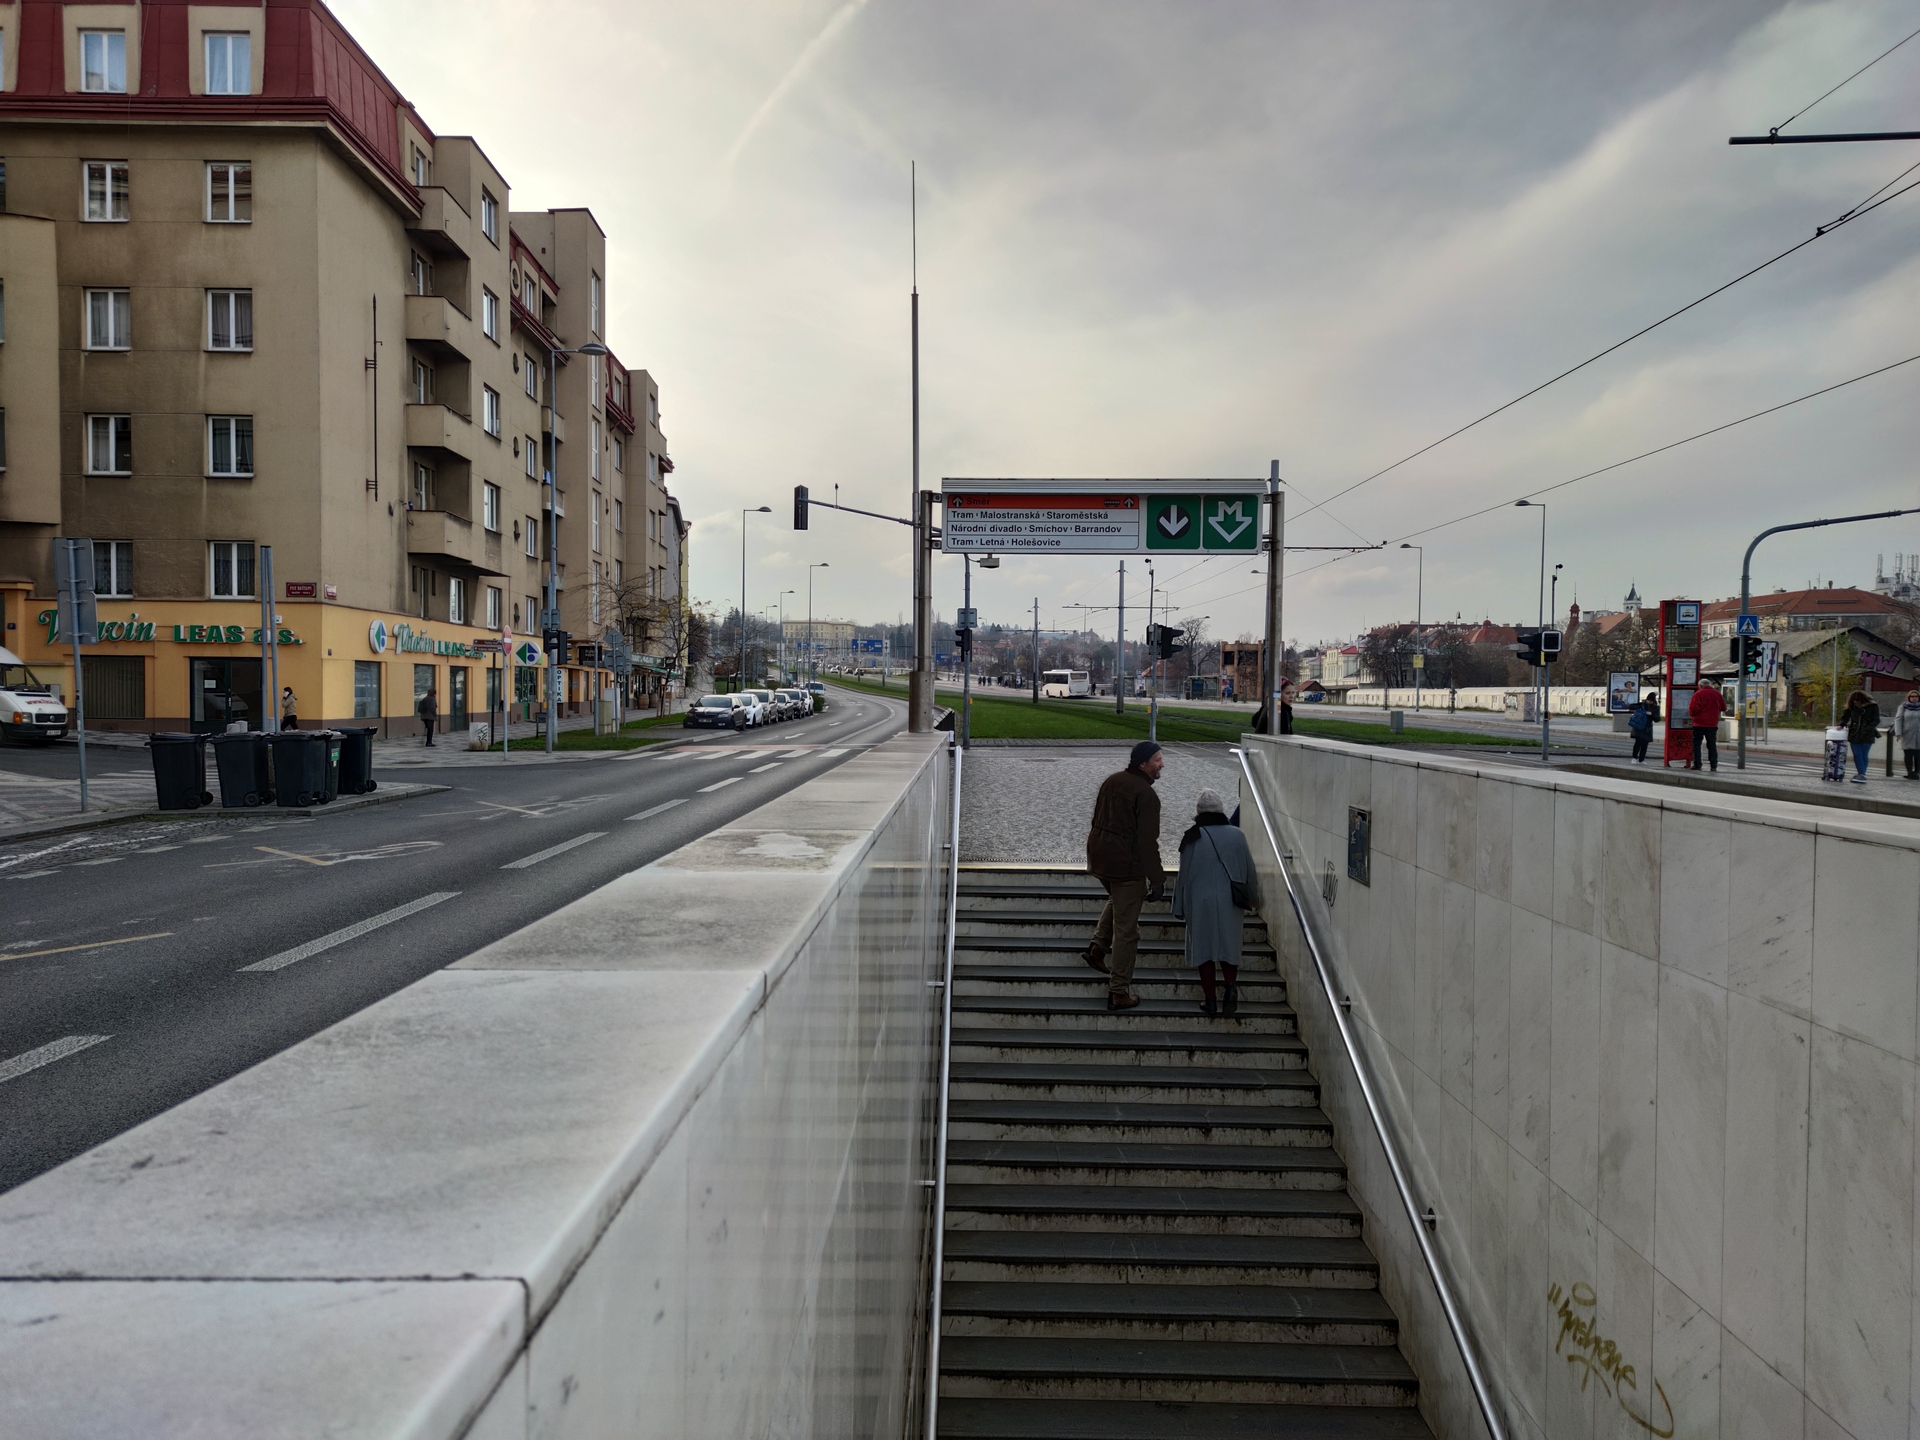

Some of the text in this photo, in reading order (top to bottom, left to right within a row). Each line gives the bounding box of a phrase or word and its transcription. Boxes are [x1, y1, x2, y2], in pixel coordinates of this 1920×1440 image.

[951, 510, 1109, 520] Tram Malostranská Staroměstská
[951, 524, 1122, 533] Národní divadlo Smíchov Barrandov
[951, 538, 1061, 546] Tram Letná Holešovice
[173, 625, 244, 643] LEAS
[436, 640, 467, 657] LEAS
